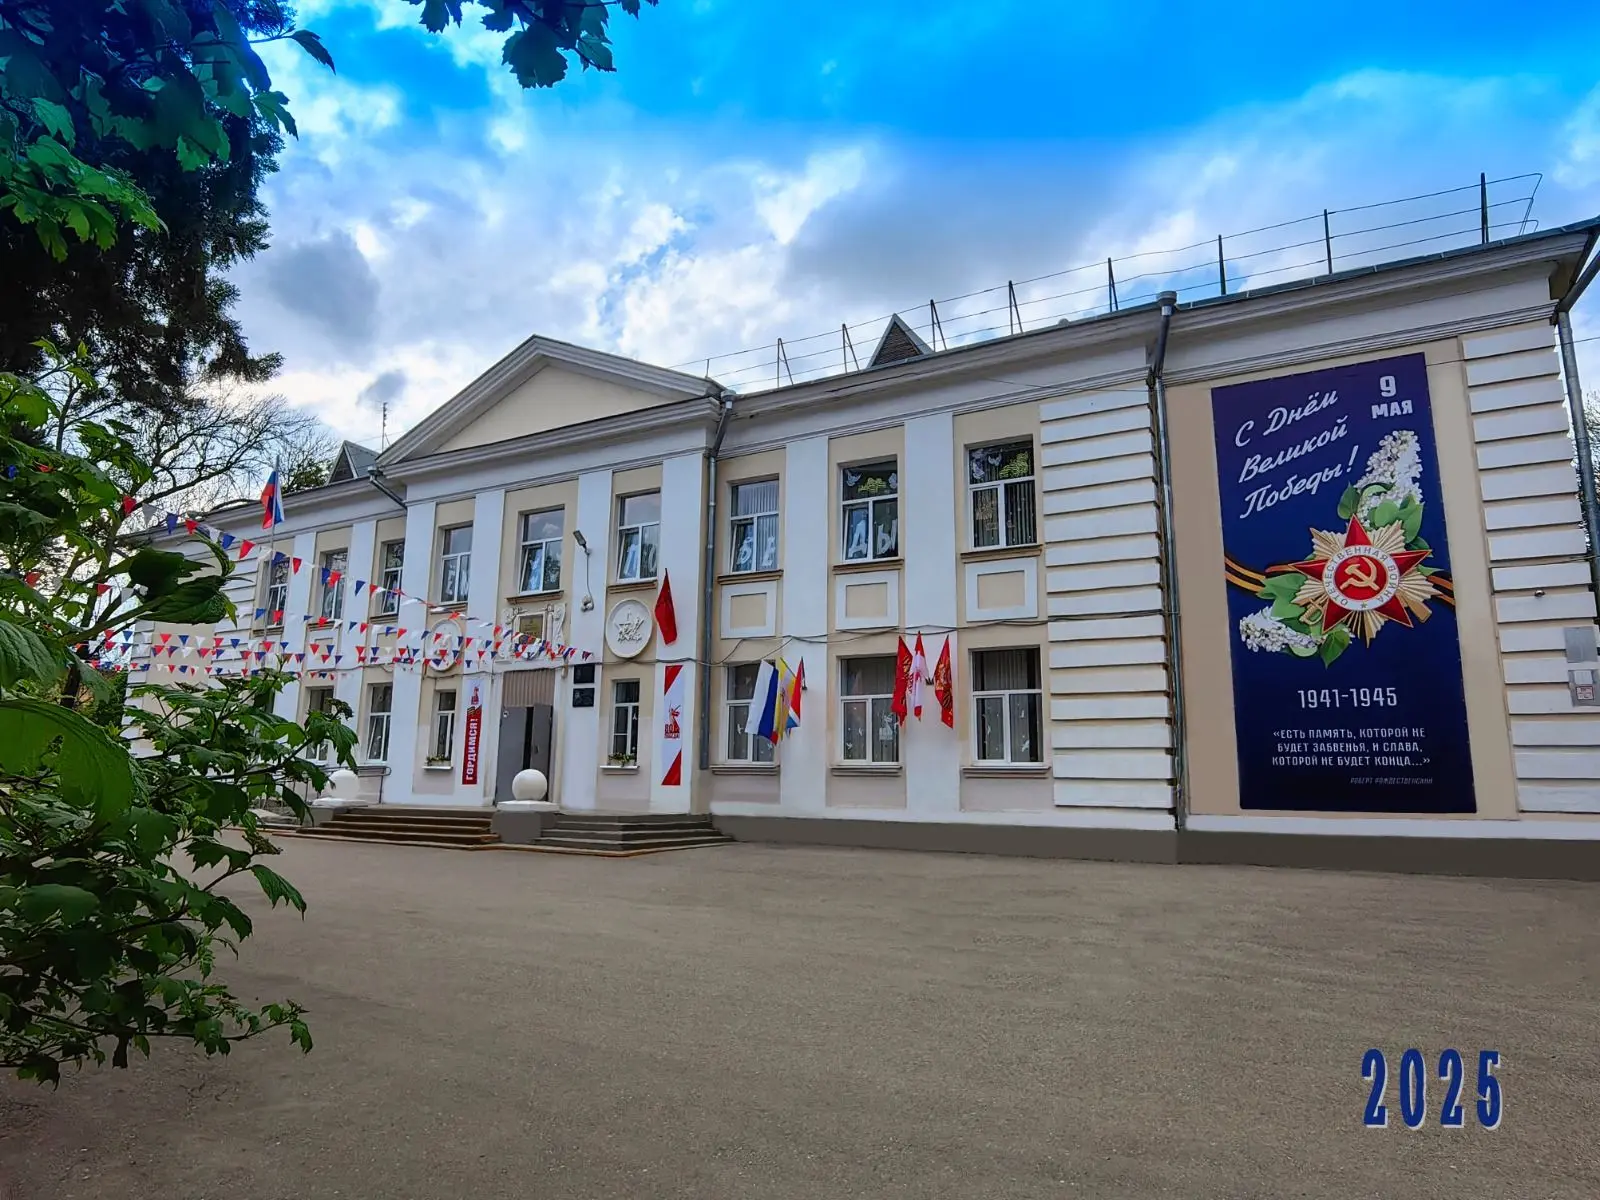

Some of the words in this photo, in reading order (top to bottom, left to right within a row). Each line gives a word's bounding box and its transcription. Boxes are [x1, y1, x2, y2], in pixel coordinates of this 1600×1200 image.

[1379, 375, 1396, 398] 9
[1235, 420, 1254, 447] С
[1263, 389, 1338, 436] Днём
[1371, 400, 1413, 419] МАЯ
[1238, 415, 1348, 483] Великой
[1298, 687, 1398, 709] 1941-1945
[1273, 729, 1306, 740] «ЕСТЬ
[1309, 728, 1356, 740] ПАМЯТЬ,
[1359, 726, 1409, 739] КОТОРОЙ
[1412, 727, 1426, 738] НЕ
[465, 718, 478, 781] ГОРДИМСЯ!
[1277, 742, 1309, 753] БУДЕТ
[1372, 742, 1379, 752] И
[1272, 755, 1318, 766] КОТОРОЙ
[1321, 756, 1334, 766] НЕ
[1337, 756, 1371, 767] БУДЕТ
